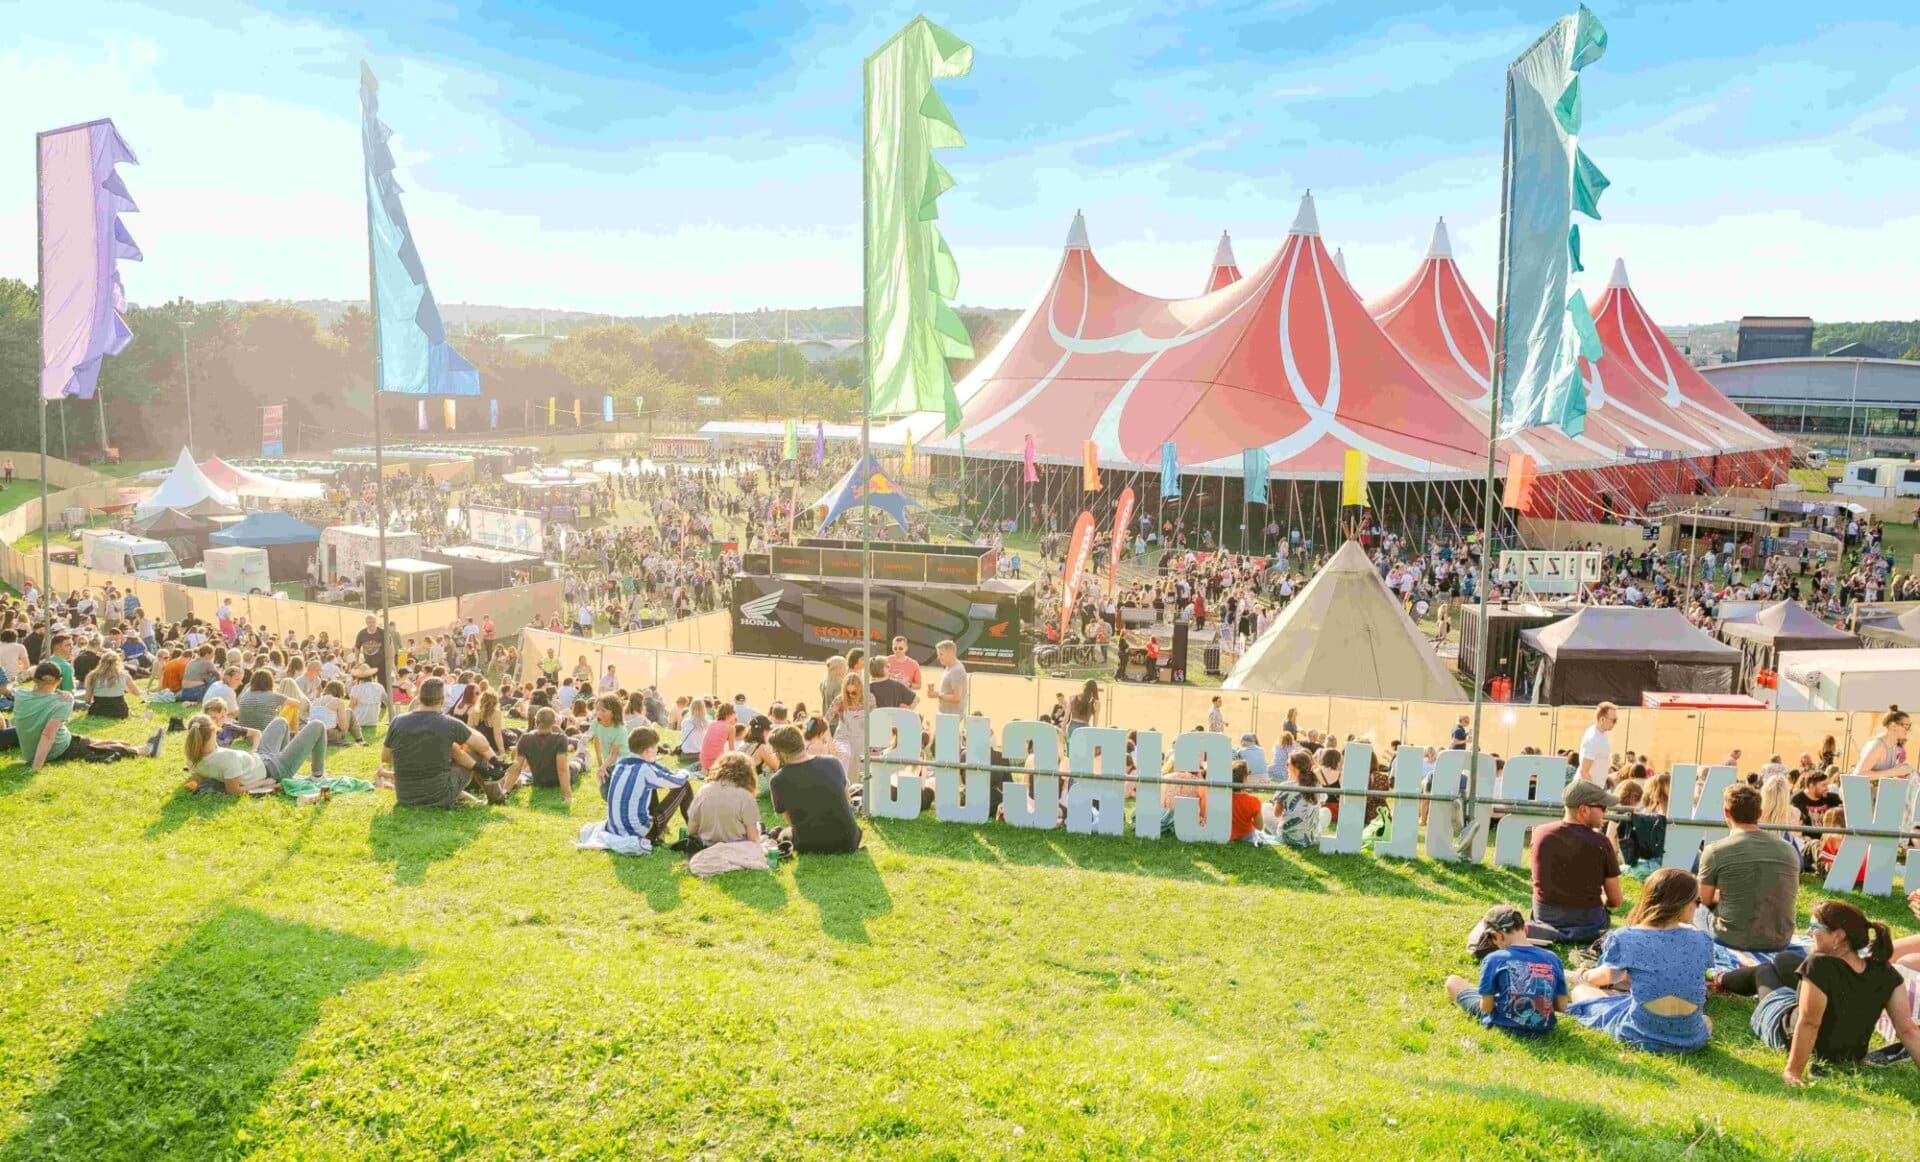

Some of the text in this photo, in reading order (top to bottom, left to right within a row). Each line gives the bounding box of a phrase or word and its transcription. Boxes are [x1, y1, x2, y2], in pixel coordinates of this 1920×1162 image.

[683, 443, 705, 457] ROLL
[1070, 525, 1094, 589] HONDA
[740, 618, 781, 628] HONDA
